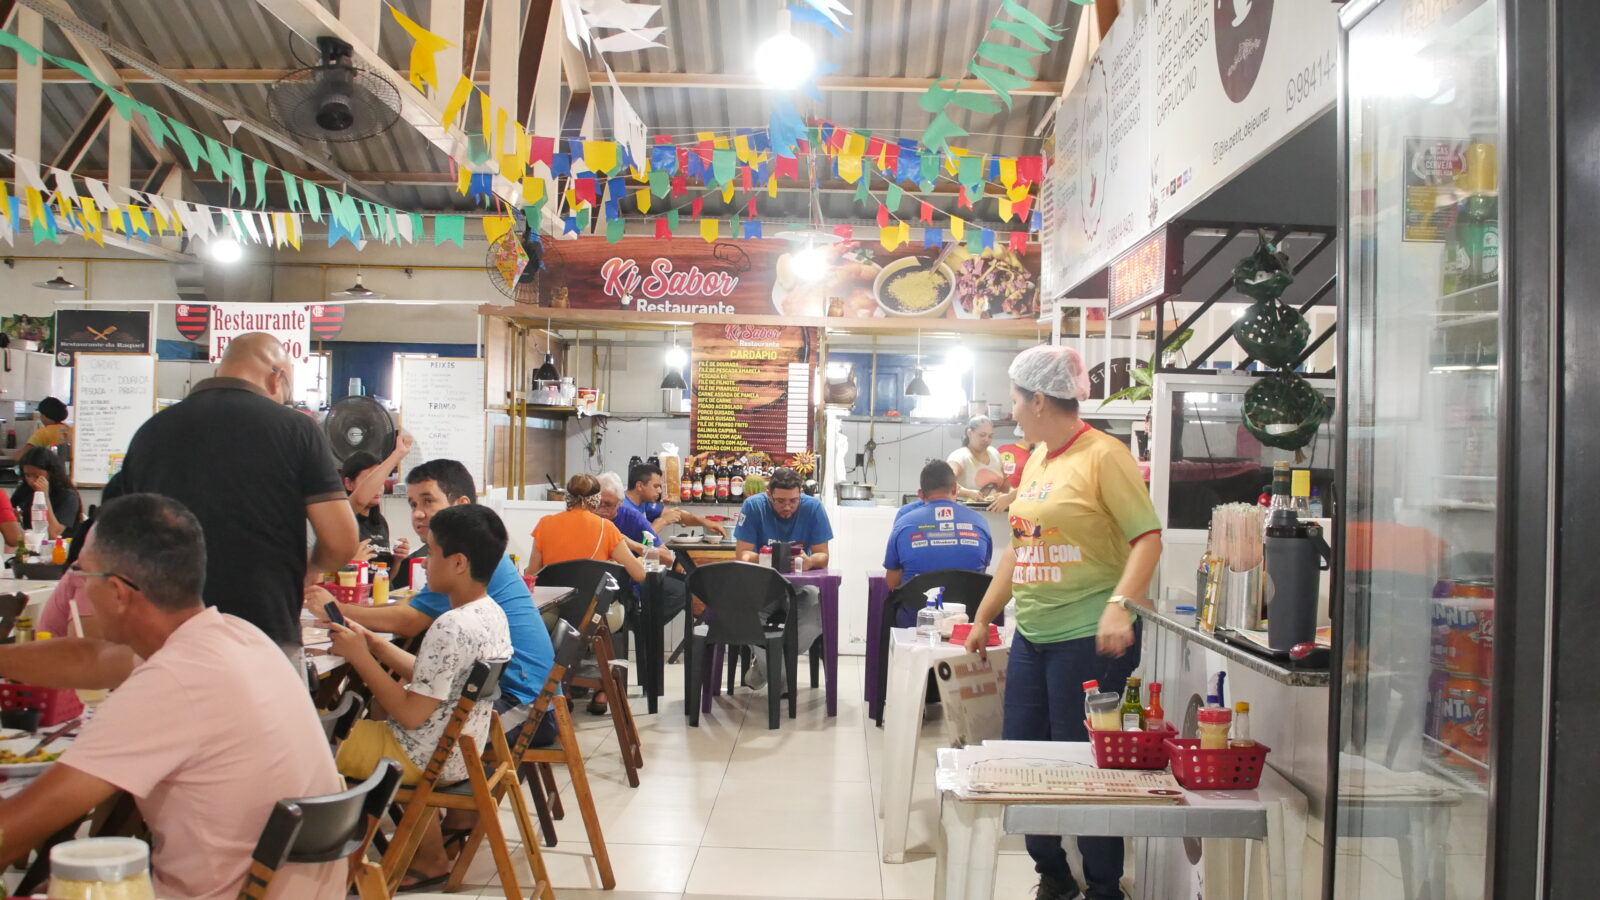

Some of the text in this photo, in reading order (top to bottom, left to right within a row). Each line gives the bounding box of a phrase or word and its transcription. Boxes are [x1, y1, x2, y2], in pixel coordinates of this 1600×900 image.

[1173, 18, 1209, 78] EXPRESSO
[1296, 49, 1337, 103] 98414-
[1156, 66, 1197, 127] CAPPUCCINO
[601, 257, 739, 298] Ki Sabor
[214, 308, 305, 331] Restaurante
[637, 298, 735, 314] Restaurante
[742, 324, 782, 341] Sabor
[1048, 544, 1083, 563] COM
